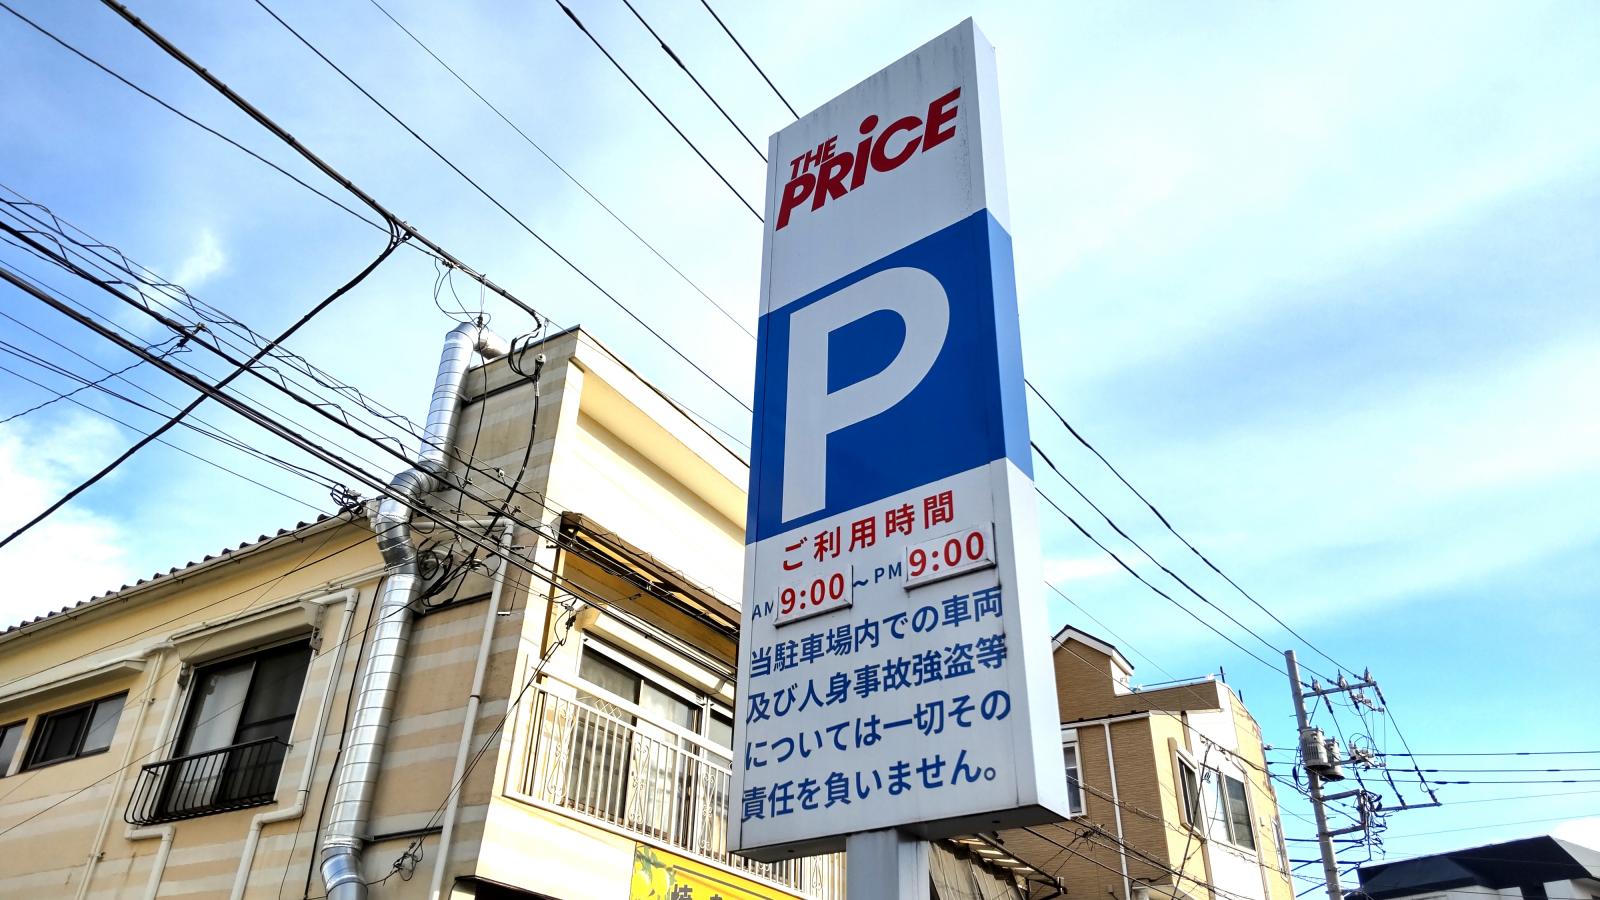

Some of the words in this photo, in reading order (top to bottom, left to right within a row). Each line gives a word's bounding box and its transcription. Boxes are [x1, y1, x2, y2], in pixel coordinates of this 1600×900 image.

[790, 135, 838, 179] THE
[781, 266, 951, 524] P
[782, 490, 954, 571] ご利用時間
[780, 572, 845, 615] 9:00
[874, 562, 902, 584] PM
[909, 531, 985, 577] 9:00
[750, 586, 1003, 679] 当駐車場内での車両
[747, 632, 1007, 725] 及び人身事故強盗等
[745, 689, 1011, 771] については一切その
[741, 750, 996, 823] 責任を負いません。
